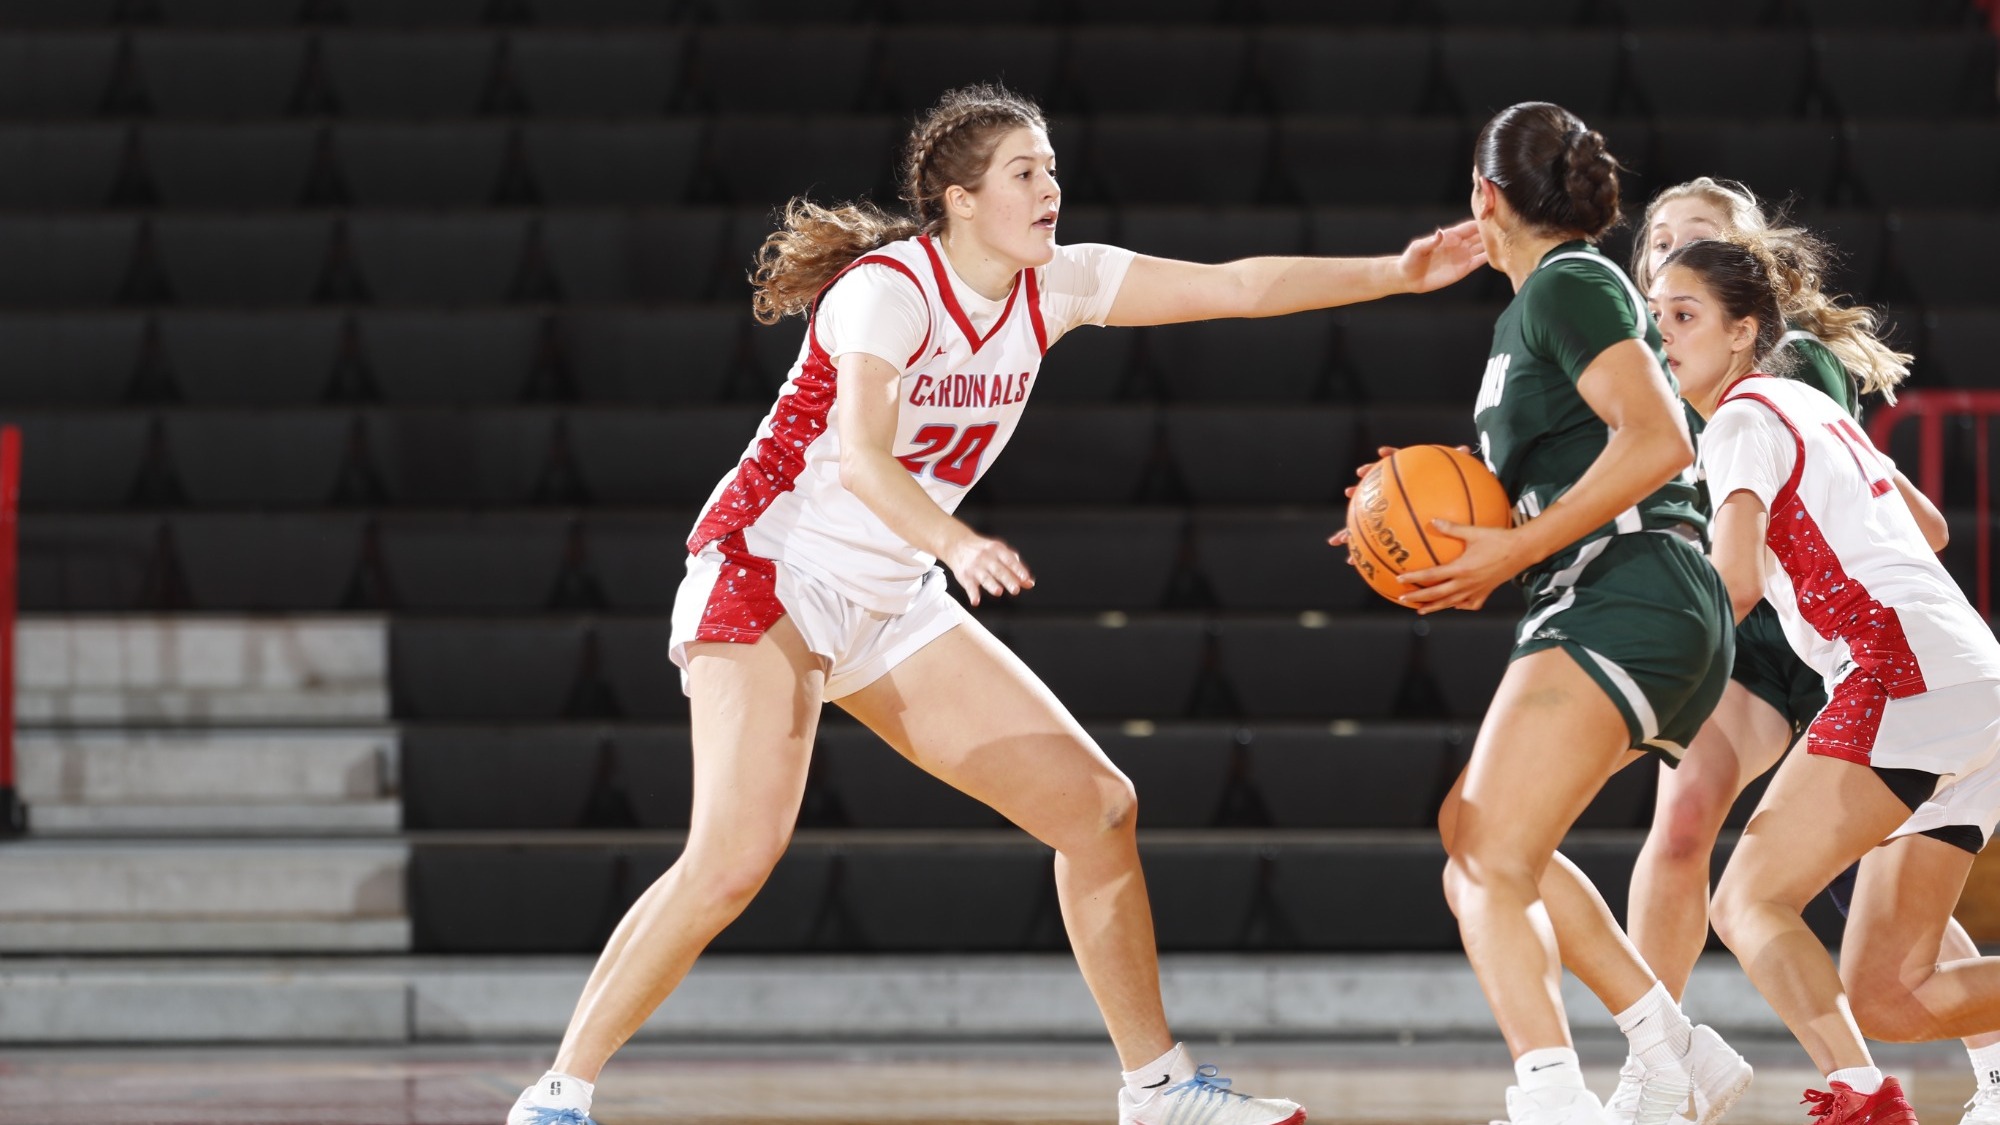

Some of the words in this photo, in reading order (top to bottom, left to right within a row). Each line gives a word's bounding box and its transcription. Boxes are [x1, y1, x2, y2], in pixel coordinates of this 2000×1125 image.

[908, 372, 1030, 408] CARDINALS
[894, 421, 1000, 489] 20
[1361, 464, 1411, 566] Wilson
